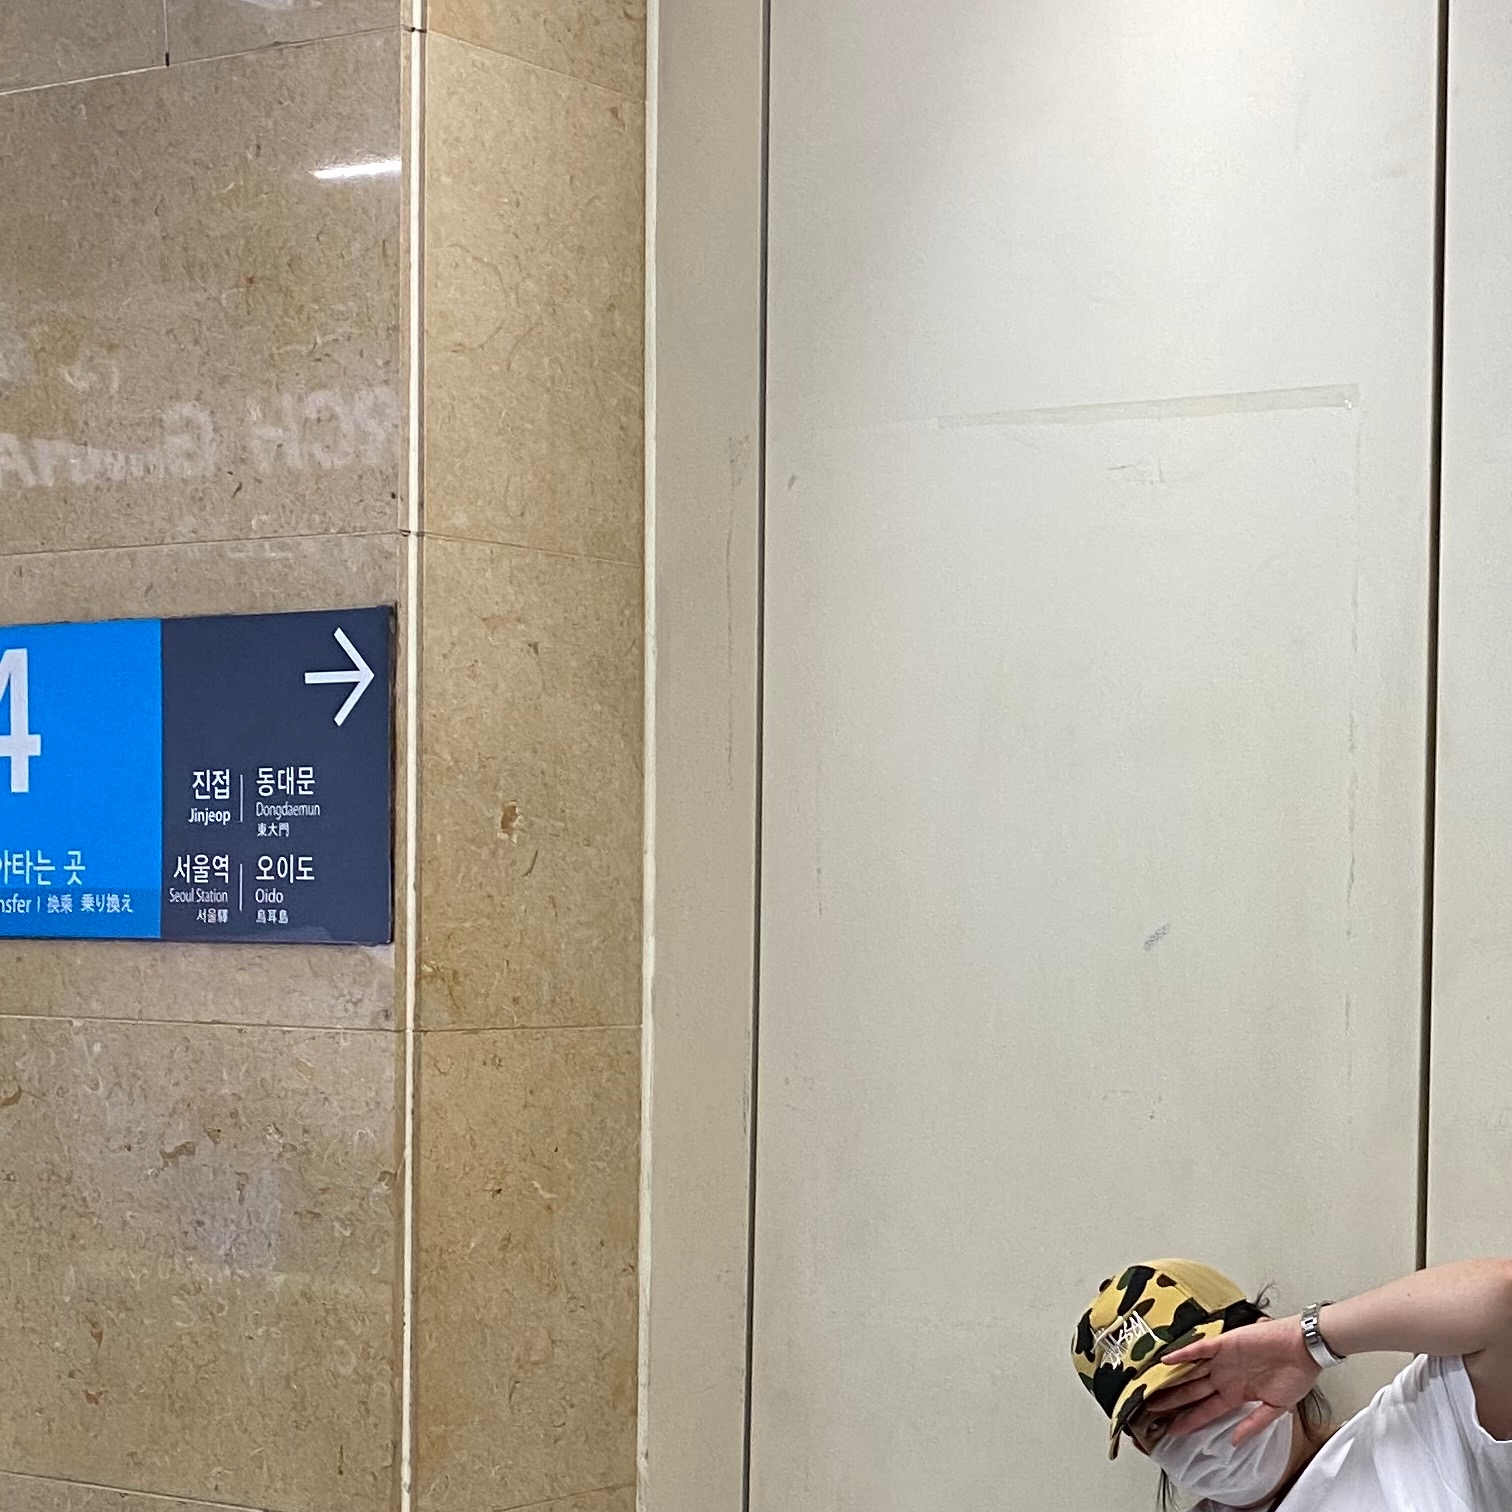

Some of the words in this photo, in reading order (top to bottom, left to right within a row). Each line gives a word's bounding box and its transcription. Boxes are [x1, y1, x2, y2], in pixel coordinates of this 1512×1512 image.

[0, 648, 42, 793] 4
[192, 768, 230, 800] 진접
[255, 766, 316, 797] 동대문
[188, 807, 231, 826] Jinjeop
[255, 800, 321, 819] Dongdaemun
[257, 822, 290, 838] 東大門
[63, 850, 86, 886] 곳
[173, 854, 229, 884] 서울역
[255, 854, 315, 884] 오이도
[169, 887, 195, 903] Seoul
[195, 887, 229, 903] Station
[255, 887, 284, 904] Oido
